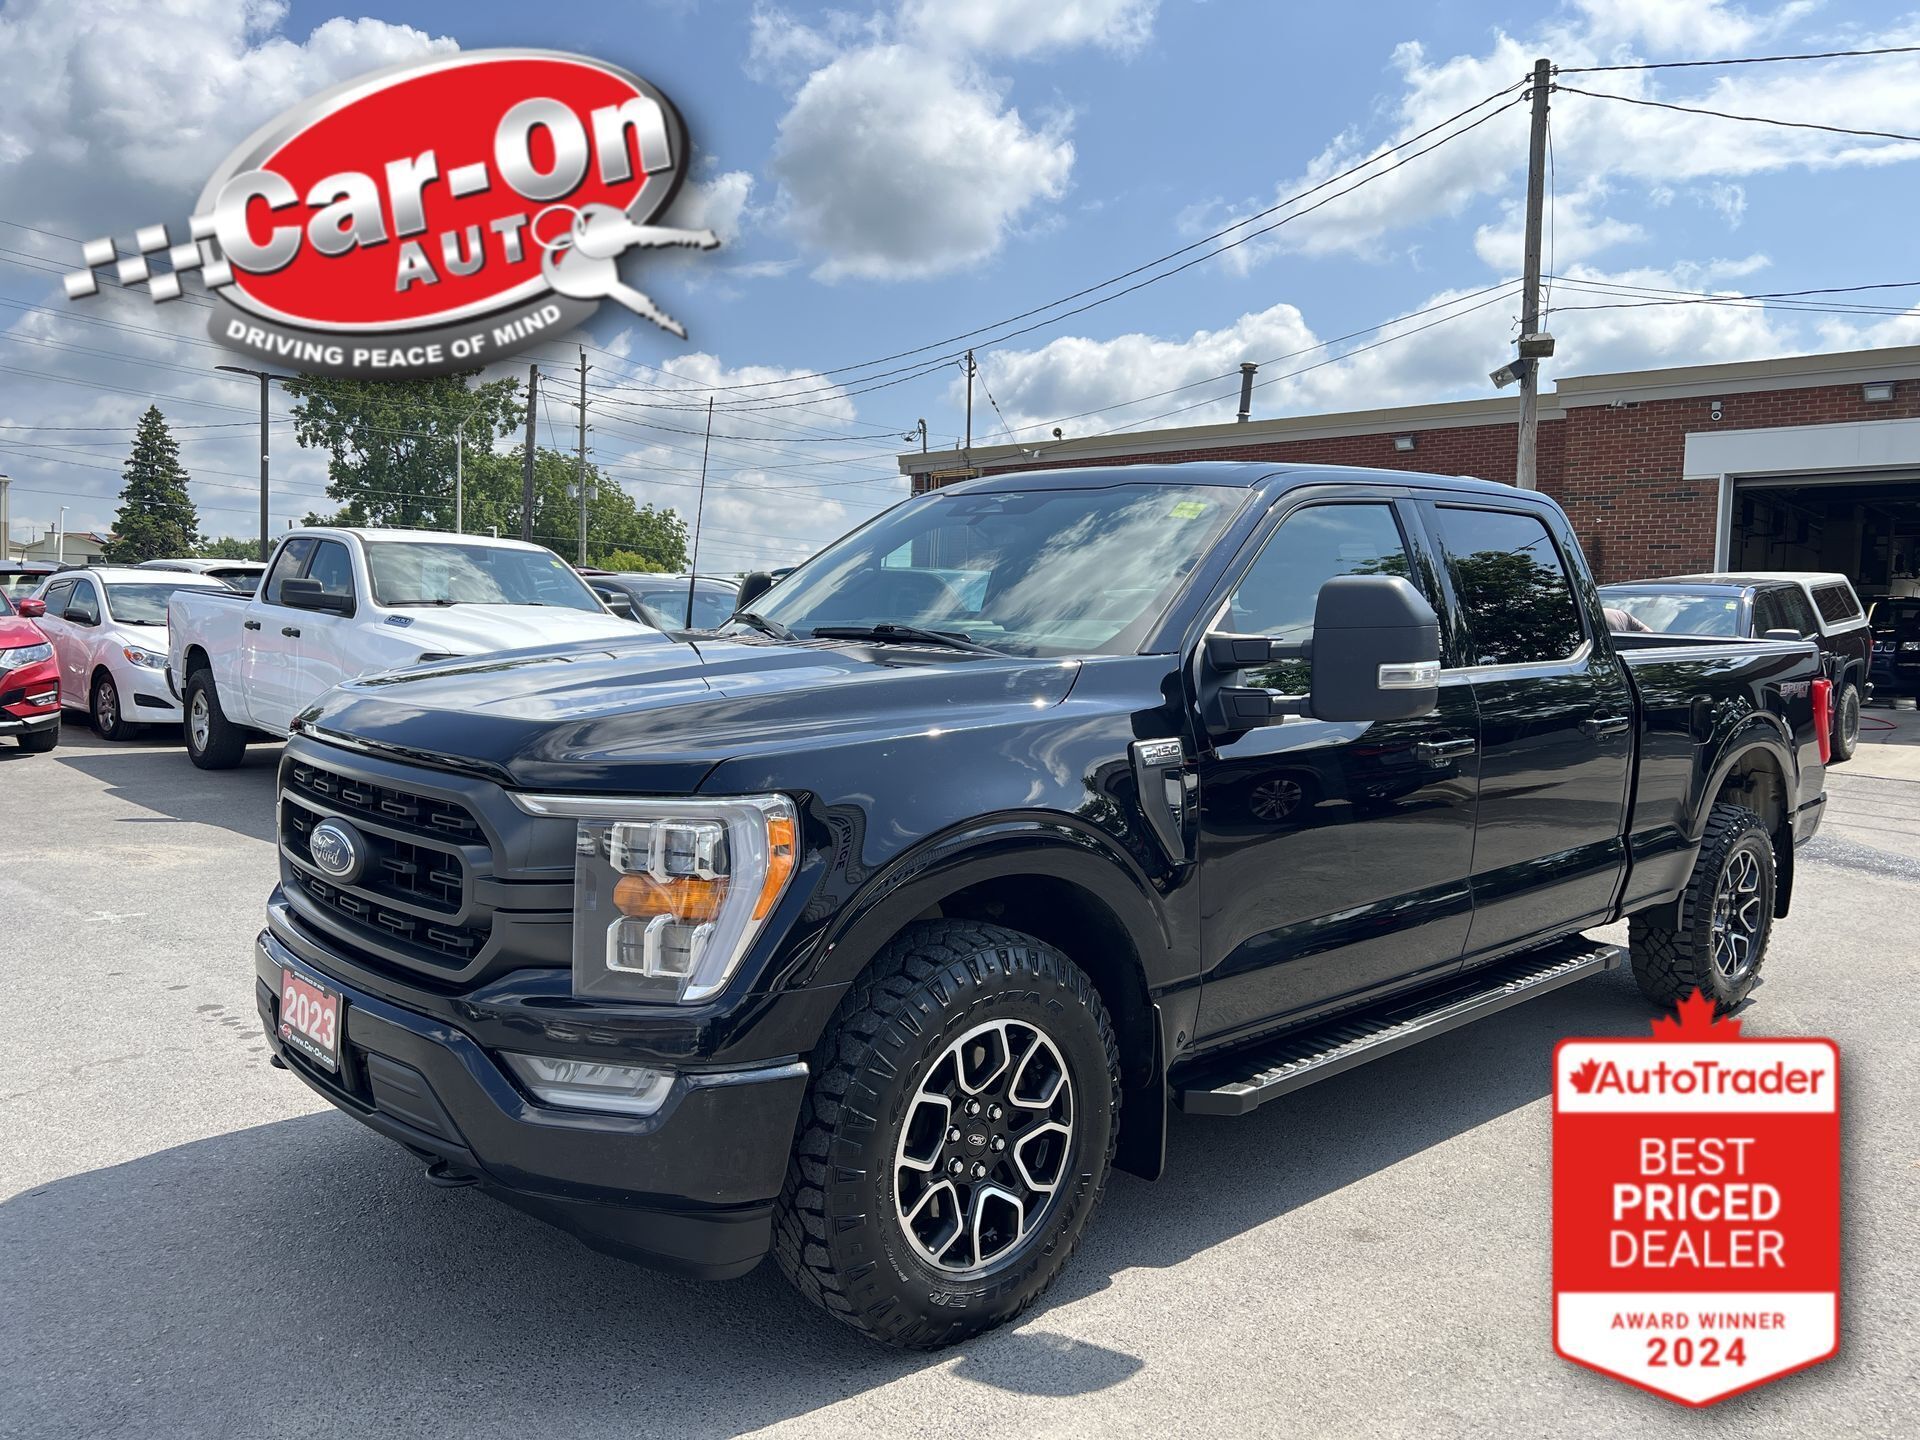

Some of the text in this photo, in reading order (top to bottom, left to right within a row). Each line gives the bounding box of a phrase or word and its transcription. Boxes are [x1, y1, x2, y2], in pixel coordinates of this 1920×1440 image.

[1141, 745, 1180, 758] F-150
[312, 834, 341, 866] Ford
[284, 986, 336, 1052] 2023
